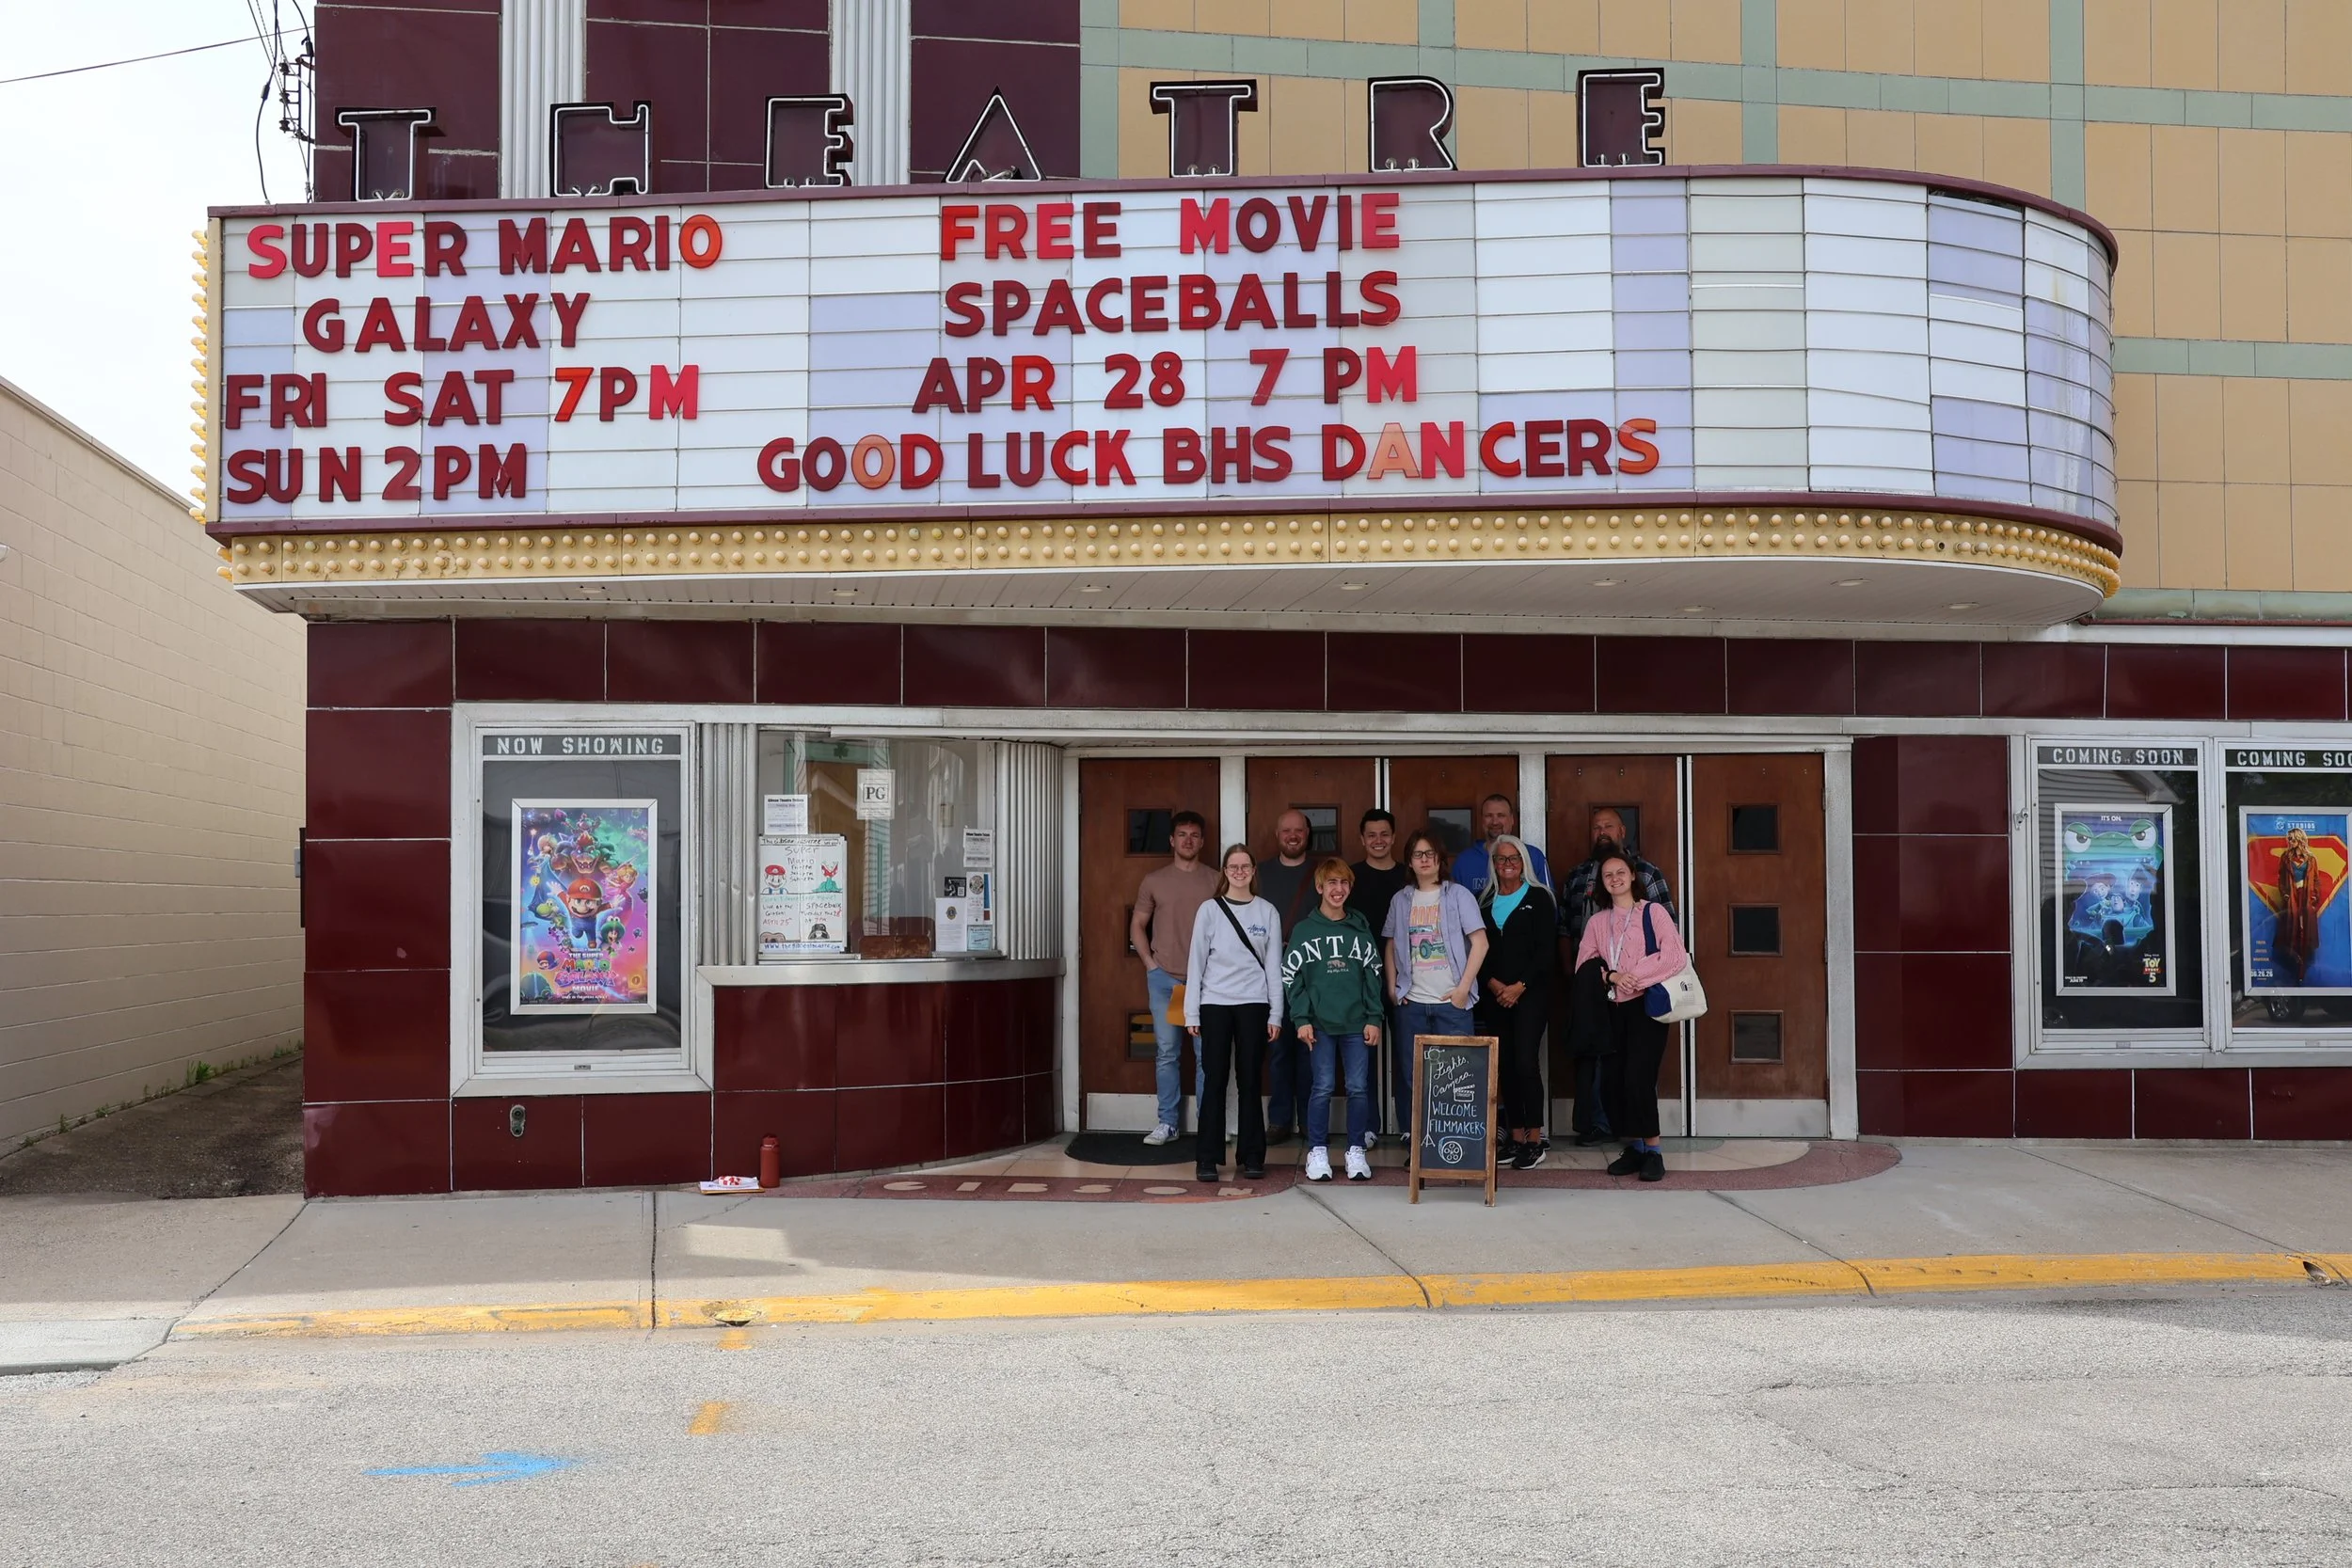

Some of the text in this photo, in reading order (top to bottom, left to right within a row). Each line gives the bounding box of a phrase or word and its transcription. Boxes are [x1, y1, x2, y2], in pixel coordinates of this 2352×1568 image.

[334, 68, 1667, 203] THEATRE
[246, 214, 723, 279] SUPER MARIO
[940, 192, 1401, 261] FREE MOVIE
[303, 292, 591, 354] GALAXY
[945, 270, 1402, 339] SPACEBALLS
[225, 363, 700, 430] FRI SAT 7PM
[912, 345, 1419, 415] APR 28 7 PM
[227, 442, 528, 504] SUN 2PM
[756, 418, 1661, 494] GOOD LUCK BHS DANCERS
[497, 736, 664, 754] NOW SHOWING
[2053, 748, 2185, 765] COMING SOON
[2237, 751, 2306, 767] COMING
[866, 786, 886, 800] PG
[2142, 958, 2161, 968] TOY
[2149, 973, 2157, 983] 5
[1429, 1118, 1486, 1135] FILMMAKERS
[1432, 1101, 1478, 1117] WELCOME
